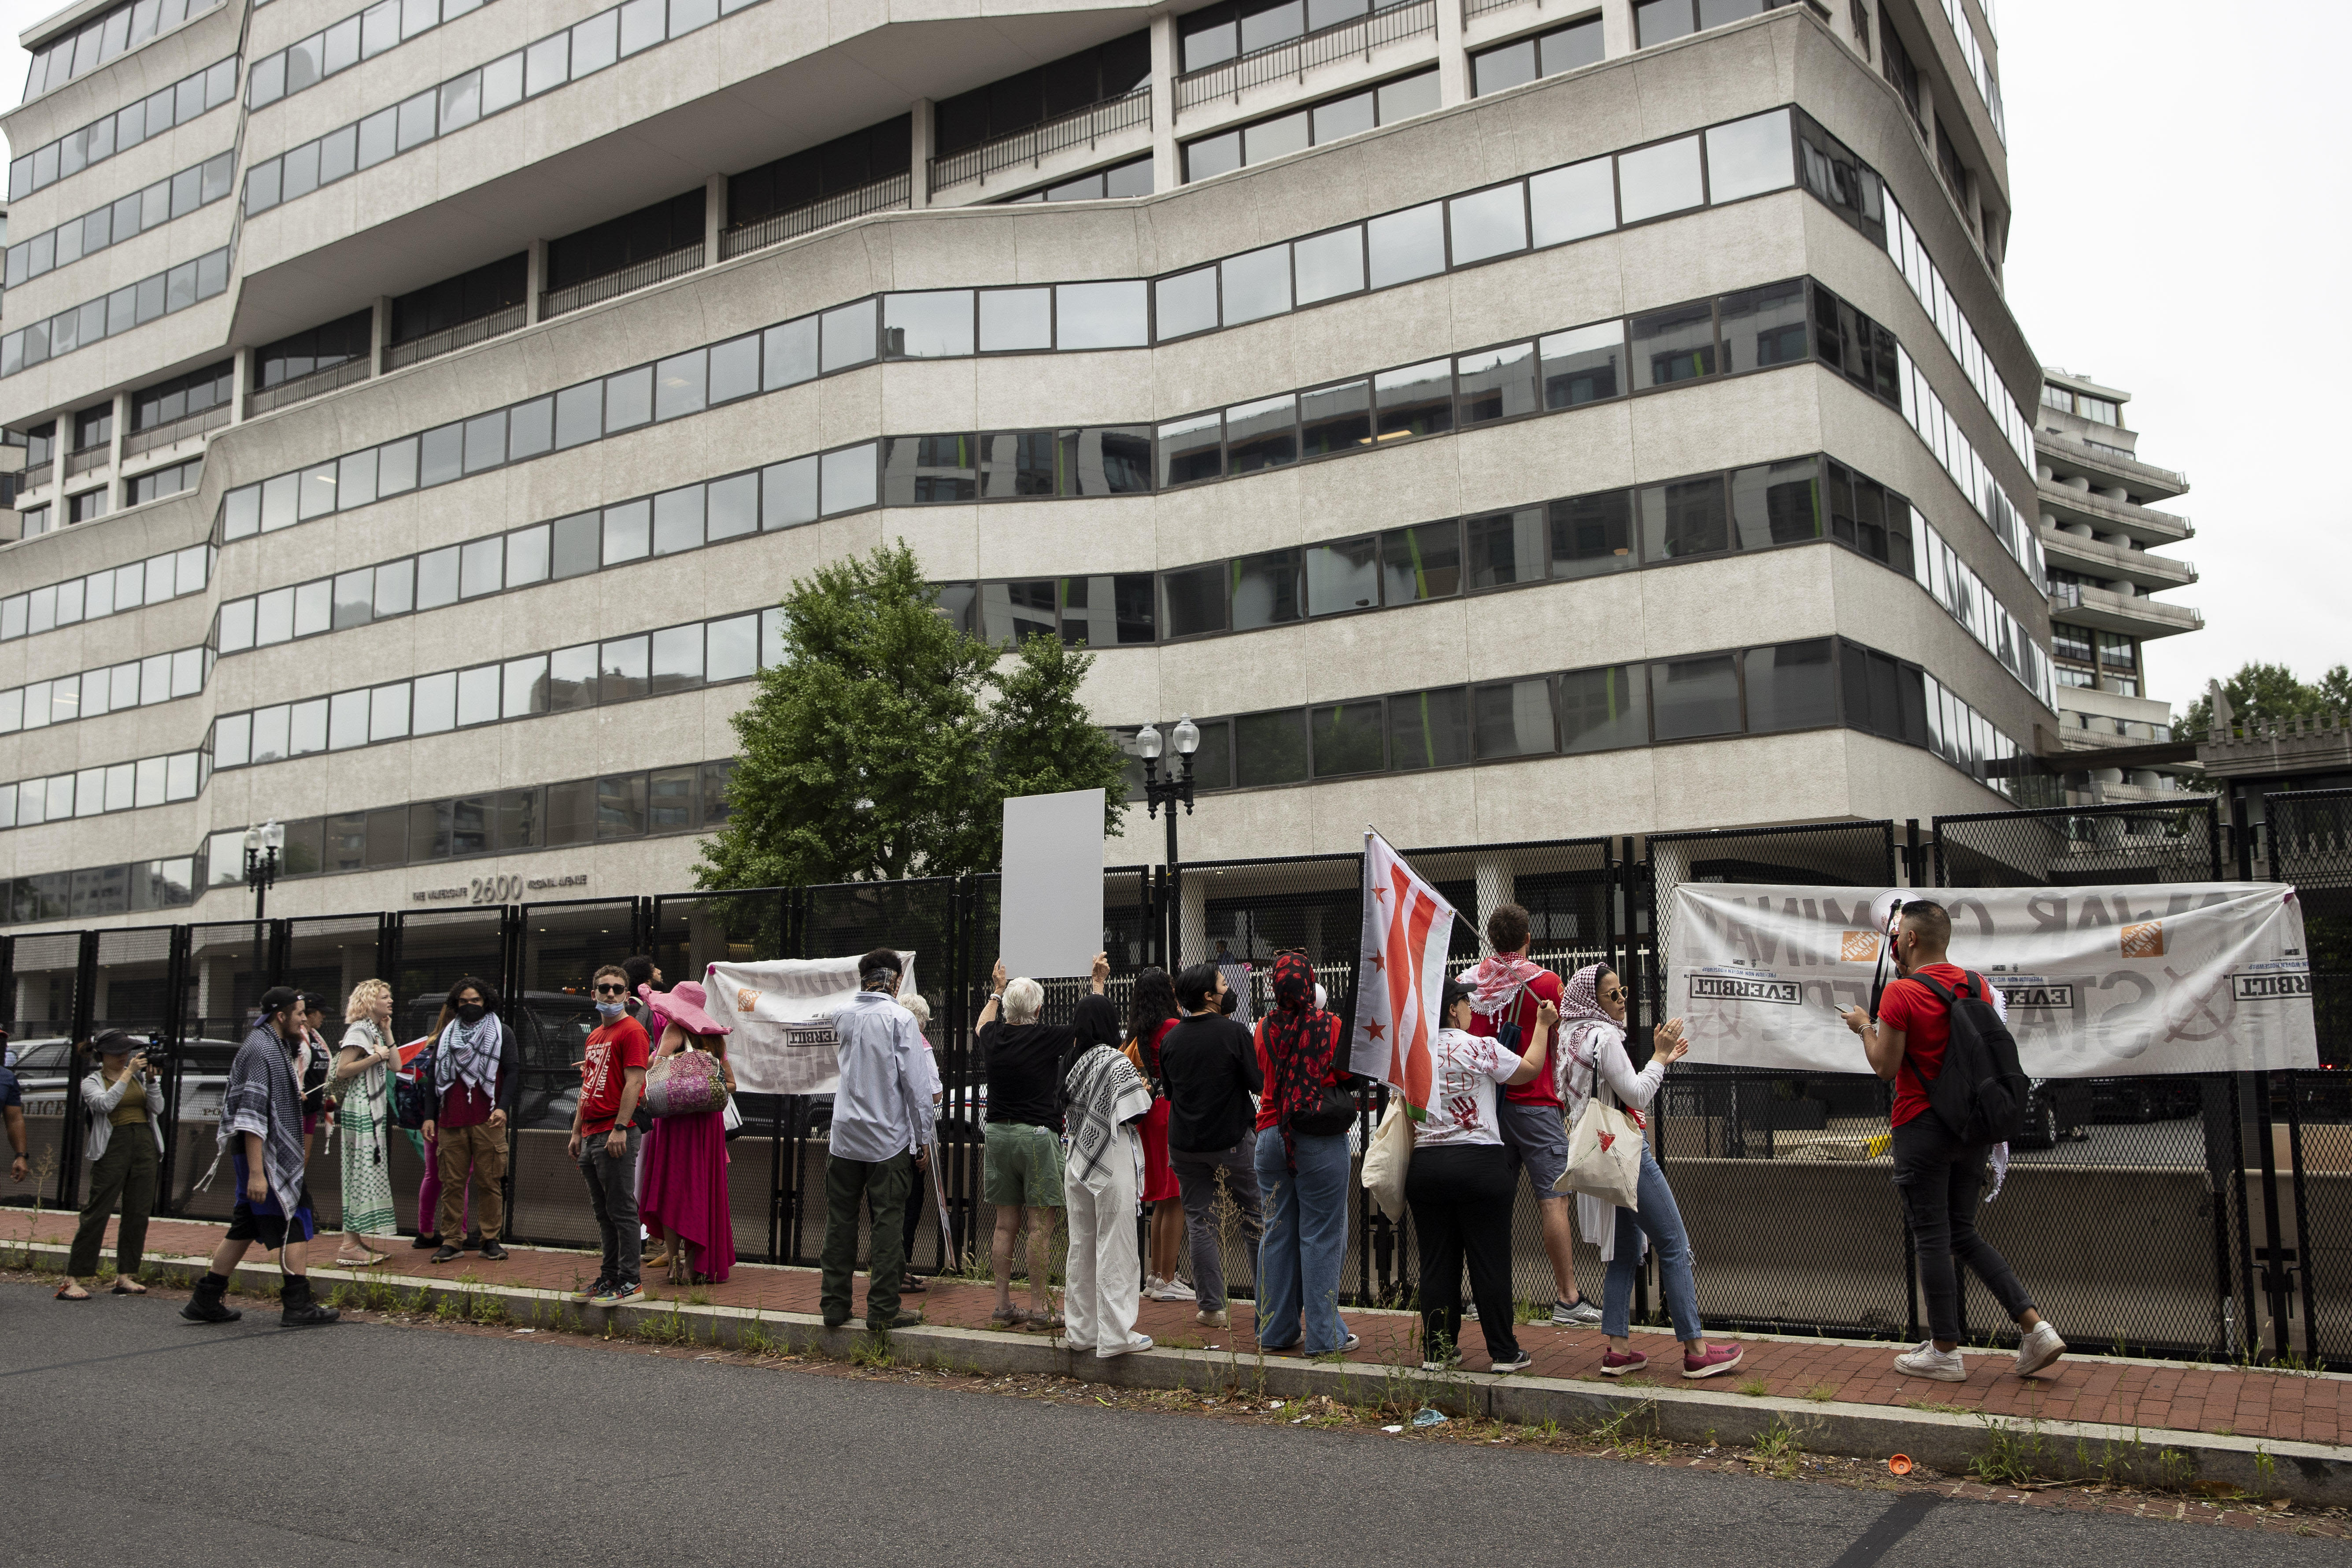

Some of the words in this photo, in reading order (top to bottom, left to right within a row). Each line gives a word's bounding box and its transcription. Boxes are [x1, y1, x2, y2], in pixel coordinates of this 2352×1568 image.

[471, 873, 524, 904] 2600
[528, 878, 558, 889] VIRGINIA
[558, 874, 587, 887] AVENUE
[413, 892, 425, 901] THE
[1842, 932, 1864, 950] DEPOT
[2121, 924, 2145, 944] DEPOT
[2121, 922, 2161, 958] HOME
[1841, 931, 1879, 962] HOME
[1859, 946, 1873, 958] THE
[2142, 939, 2157, 953] THE
[1695, 979, 1796, 1001] EVERBILT
[2240, 975, 2311, 996] RBILT
[1999, 988, 2067, 1005] EVER
[790, 1030, 838, 1044] VERBILT
